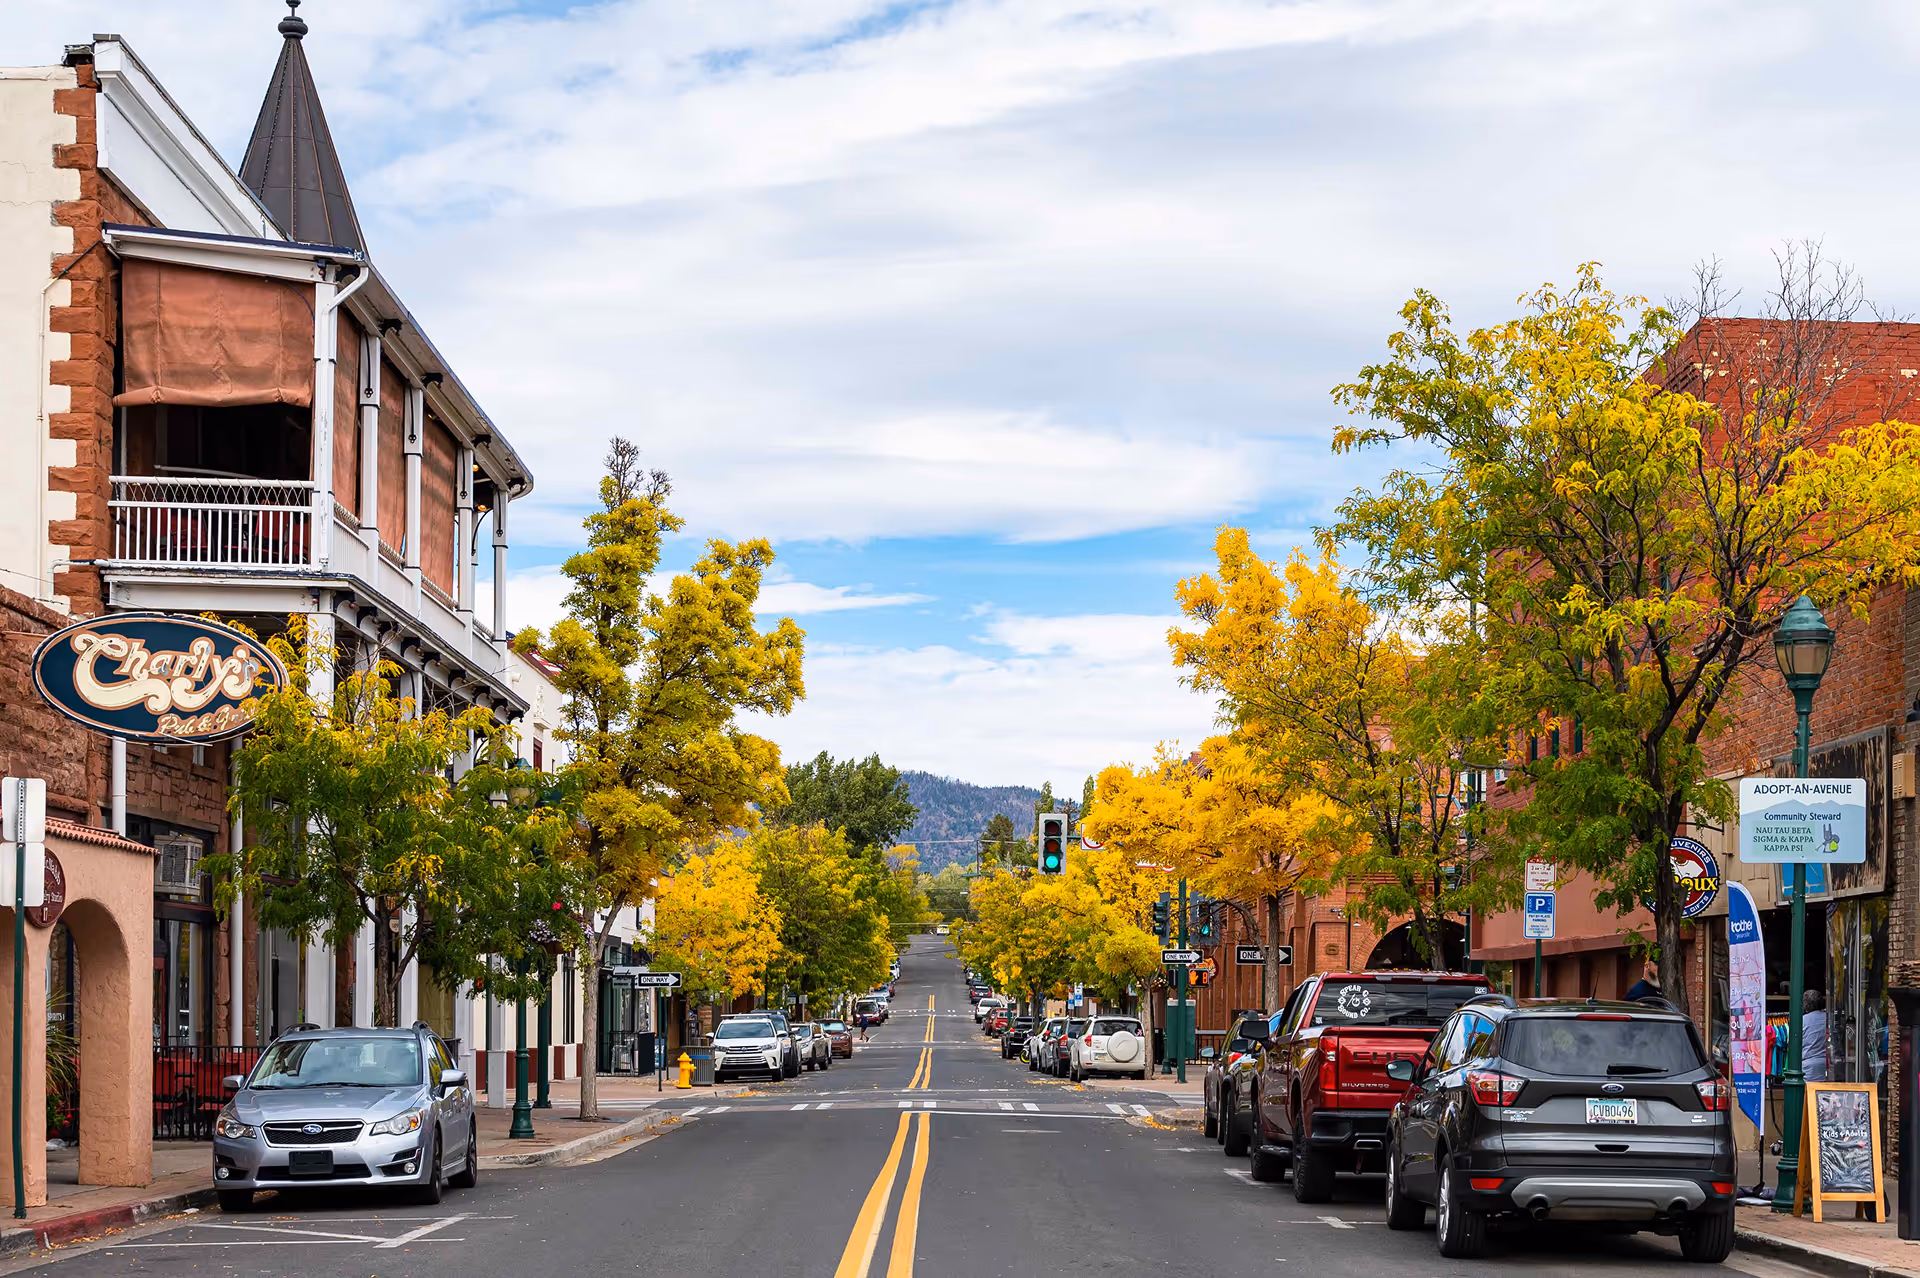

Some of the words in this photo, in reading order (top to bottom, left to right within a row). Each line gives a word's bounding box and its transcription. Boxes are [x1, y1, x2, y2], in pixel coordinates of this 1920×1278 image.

[74, 633, 258, 712] Charly's
[159, 714, 195, 735] Pub
[197, 715, 213, 732] &
[1753, 784, 1852, 794] ADOPT-AN-AVENUE
[1764, 812, 1807, 821] Community
[1809, 812, 1842, 821] Steward
[1671, 840, 1711, 864] UVENIRS
[1535, 898, 1546, 911] P
[1689, 895, 1709, 912] GIFTS
[1241, 951, 1257, 959] ONE
[1593, 1104, 1634, 1118] CVB0496
[1823, 1130, 1838, 1138] Kids
[1845, 1129, 1868, 1137] Adults
